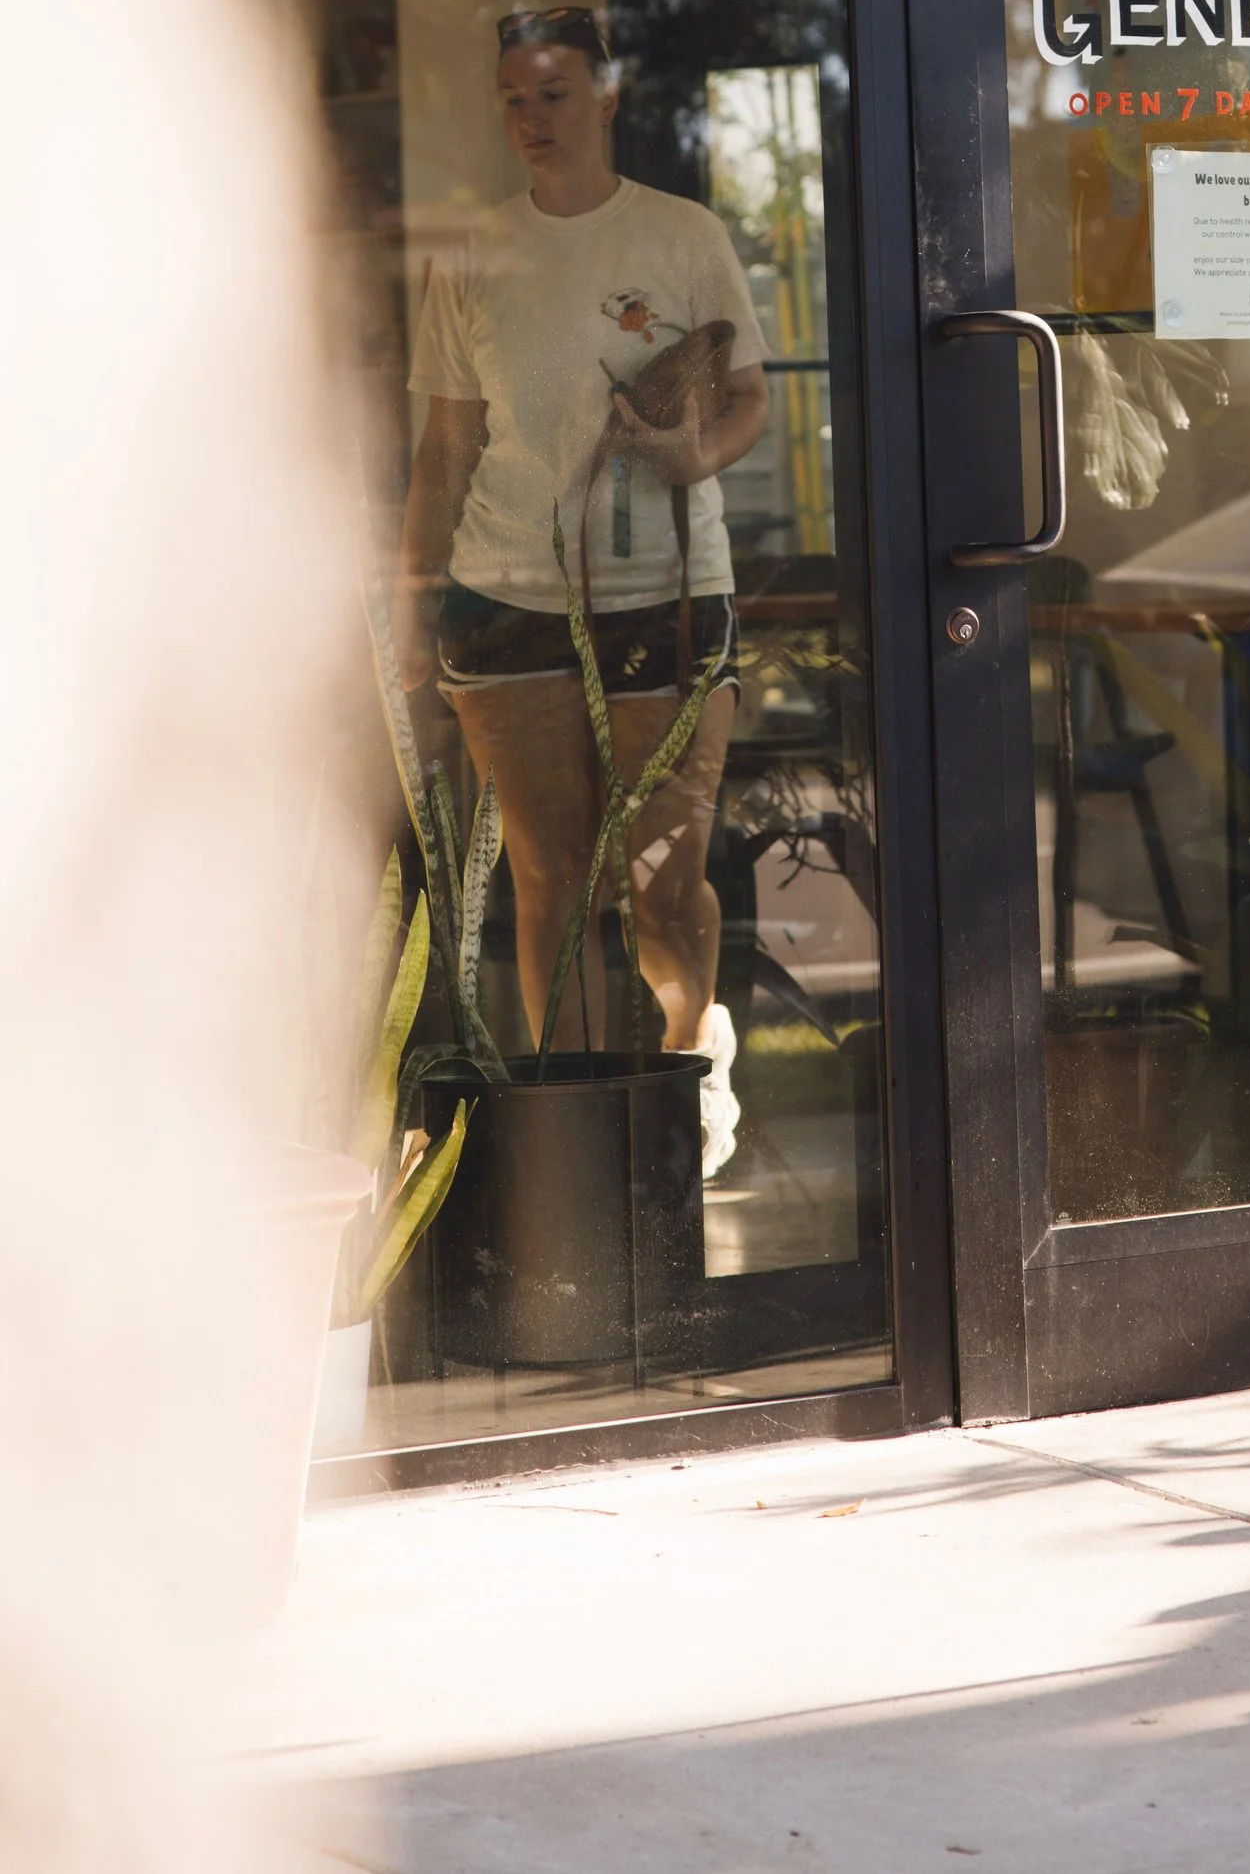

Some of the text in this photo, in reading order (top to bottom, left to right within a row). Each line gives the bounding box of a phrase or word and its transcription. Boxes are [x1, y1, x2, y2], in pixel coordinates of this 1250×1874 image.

[1068, 92, 1161, 117] OPEN
[1177, 88, 1199, 121] 7
[1195, 173, 1212, 185] We
[1214, 174, 1236, 185] love
[1193, 217, 1208, 225] Due
[1220, 217, 1243, 225] health
[1216, 230, 1242, 238] control
[1193, 256, 1213, 265] enjoy
[1229, 256, 1244, 264] side
[1193, 268, 1206, 276] We
[1208, 269, 1246, 278] appreciate
